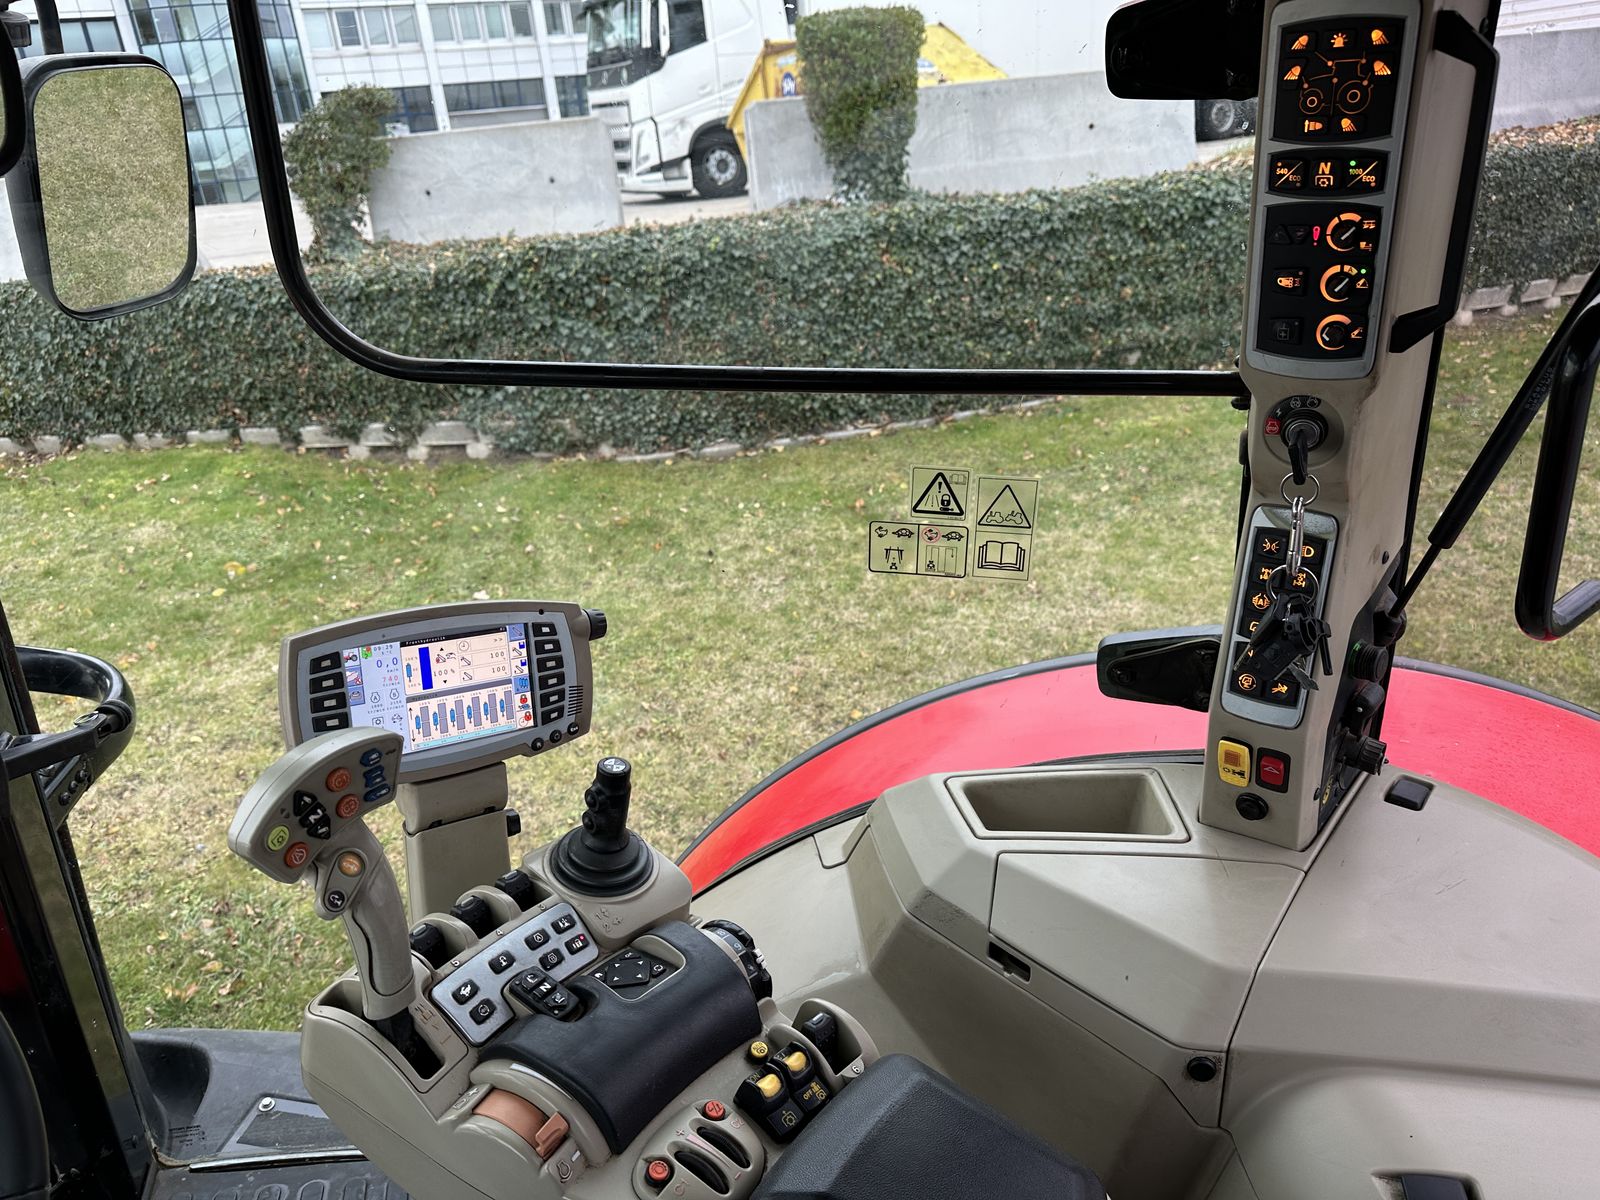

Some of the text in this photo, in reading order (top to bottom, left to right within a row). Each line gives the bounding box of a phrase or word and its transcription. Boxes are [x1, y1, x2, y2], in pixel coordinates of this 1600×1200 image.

[1276, 167, 1289, 175] 540
[1318, 161, 1332, 175] N
[1349, 168, 1363, 176] 1000
[1289, 174, 1301, 182] ECO
[490, 651, 505, 659] 100
[492, 665, 506, 674] 100
[309, 808, 323, 823] N
[450, 958, 461, 967] 5
[539, 981, 552, 993] N
[851, 1064, 861, 1074] 6
